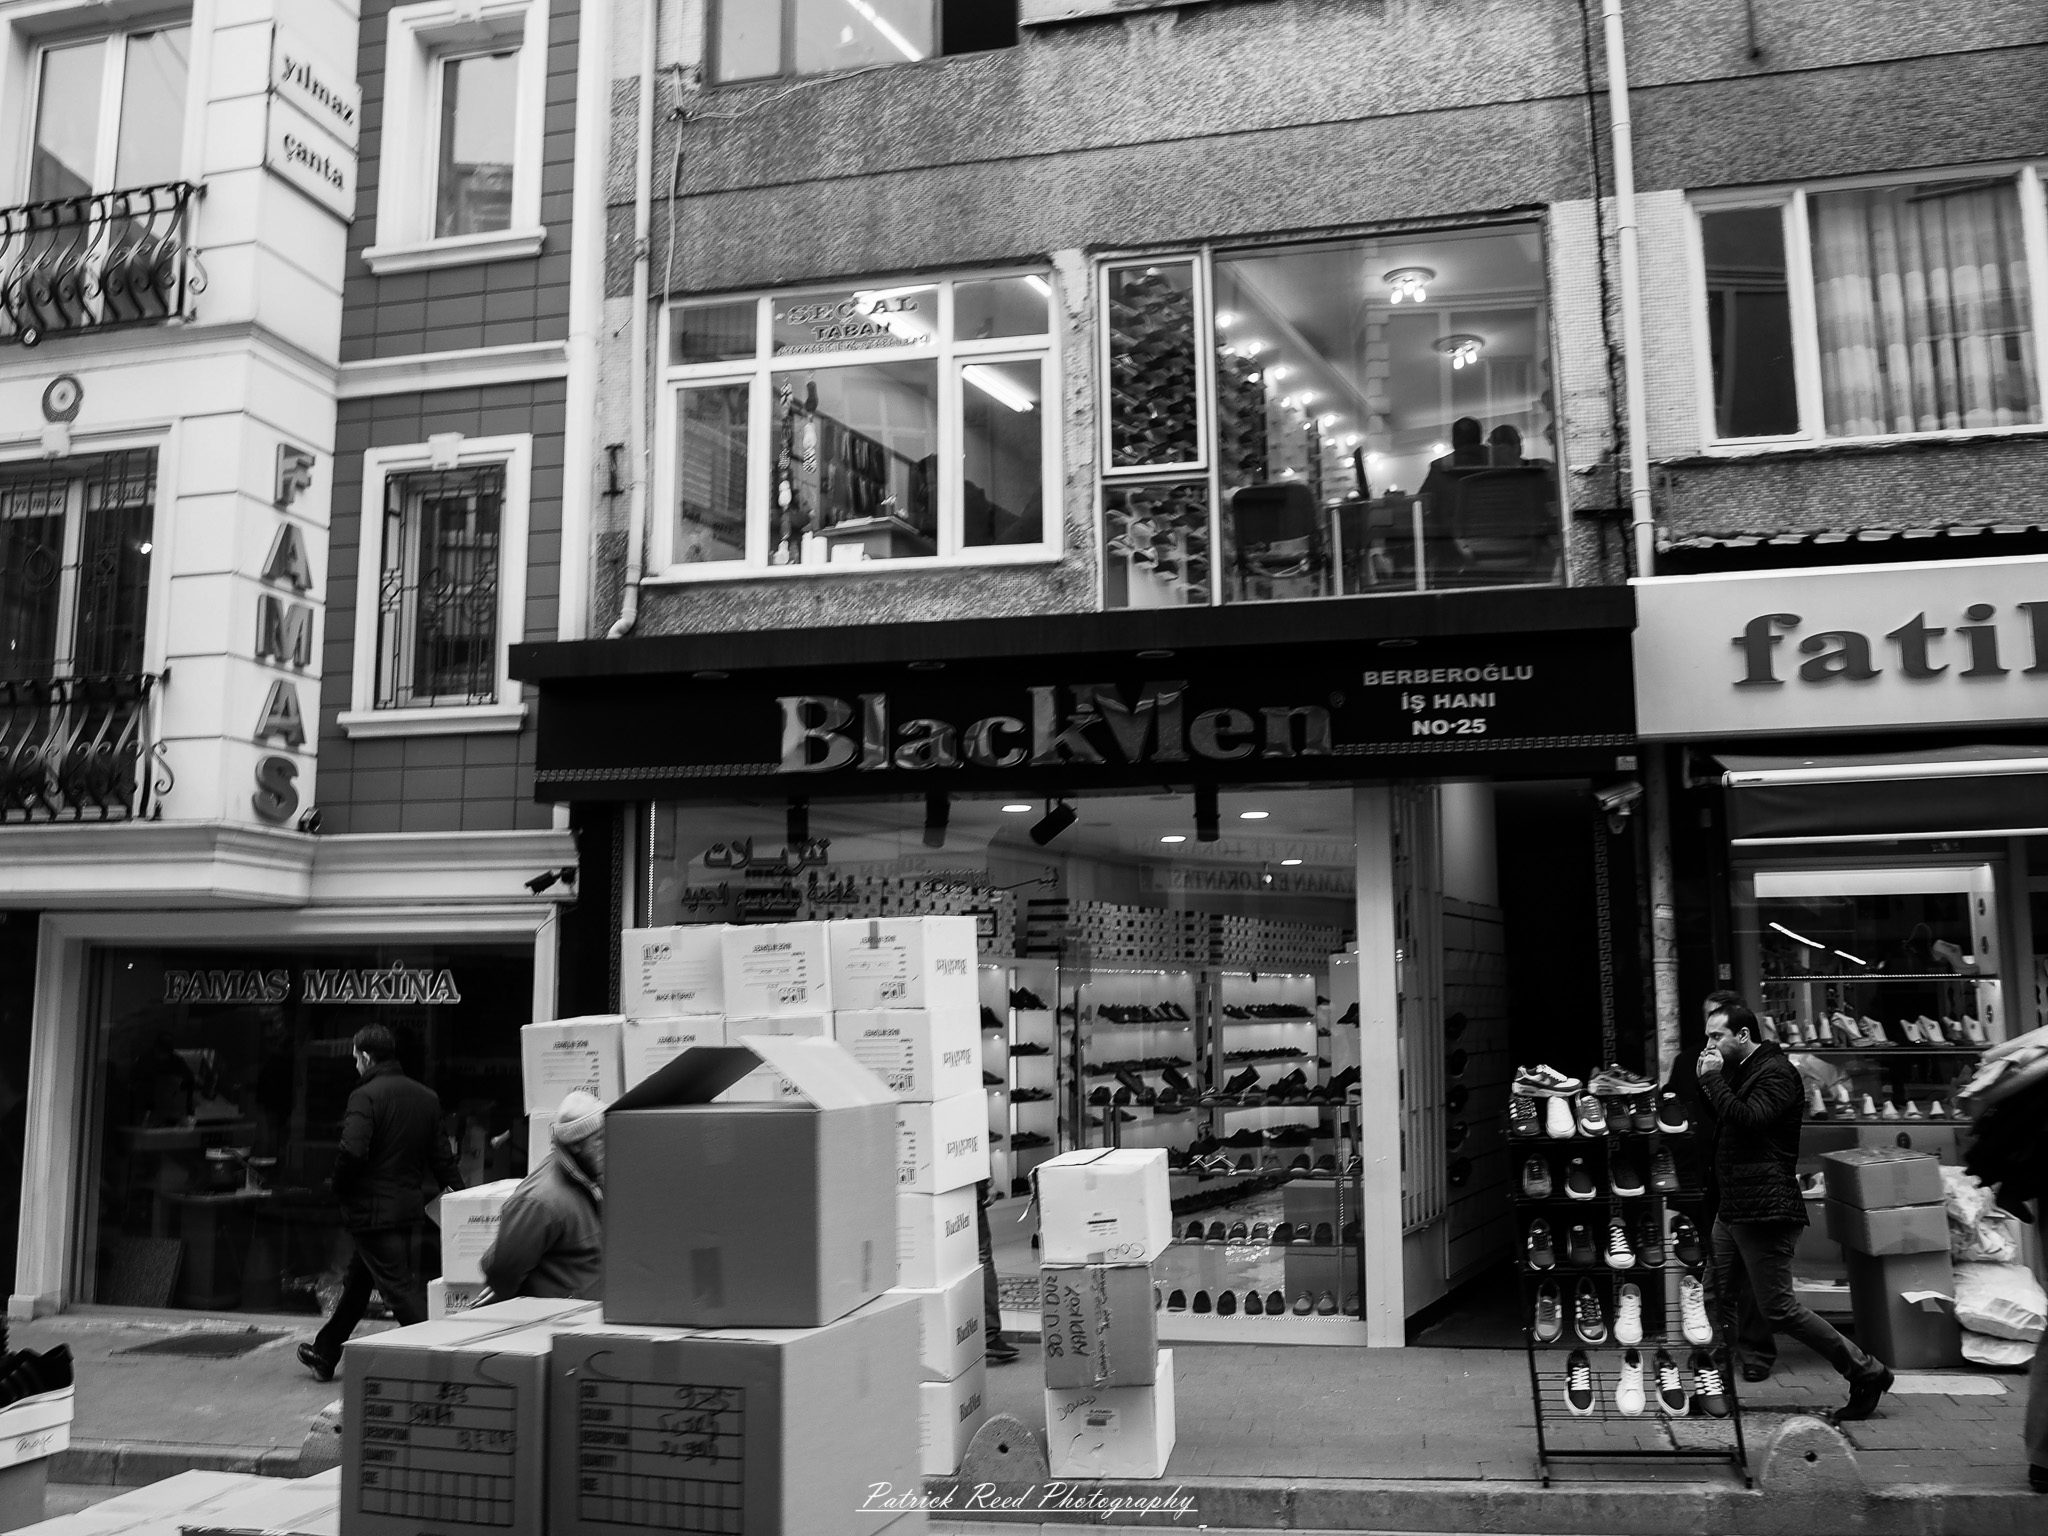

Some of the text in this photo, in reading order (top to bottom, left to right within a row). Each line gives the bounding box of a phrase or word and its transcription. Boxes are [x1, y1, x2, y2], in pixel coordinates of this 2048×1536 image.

[281, 54, 354, 126] yılmaz
[282, 132, 345, 192] çanta
[811, 321, 892, 342] TABAN
[251, 442, 316, 823] FAMAS
[1362, 663, 1534, 687] BERBEROĞLU
[1400, 691, 1497, 714] İŞ HANI
[164, 959, 461, 1004] FAMAS MAKİNA
